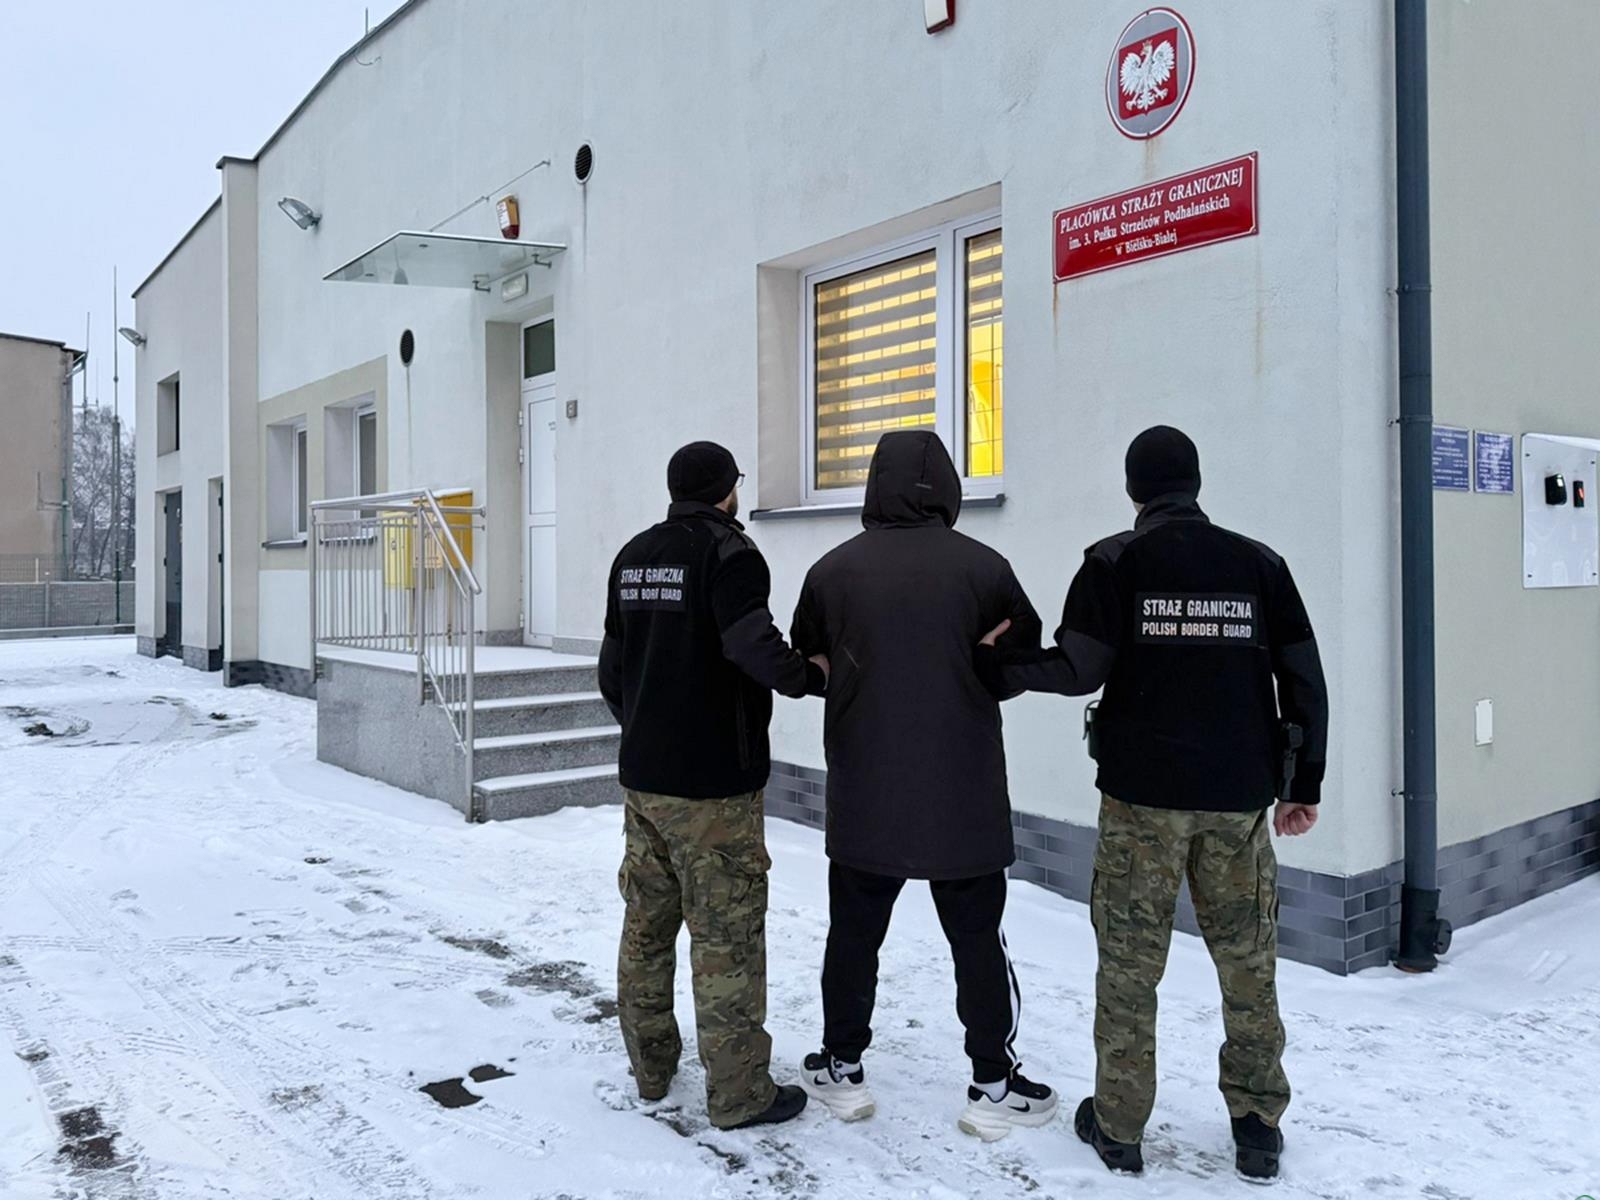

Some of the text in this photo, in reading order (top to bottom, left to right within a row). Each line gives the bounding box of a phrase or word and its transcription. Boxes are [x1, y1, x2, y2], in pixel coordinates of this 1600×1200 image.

[1060, 167, 1244, 235] PLACÓWKA STRAŻY GRANICZNEJ
[1068, 193, 1231, 250] im. 3. Pułku Strzelców Podhalańskich
[1114, 228, 1178, 256] w Bielsku-Białej
[1143, 599, 1252, 619] STRAŻ GRANICZNA
[1142, 622, 1252, 638] POLISH BORDER GUARD
